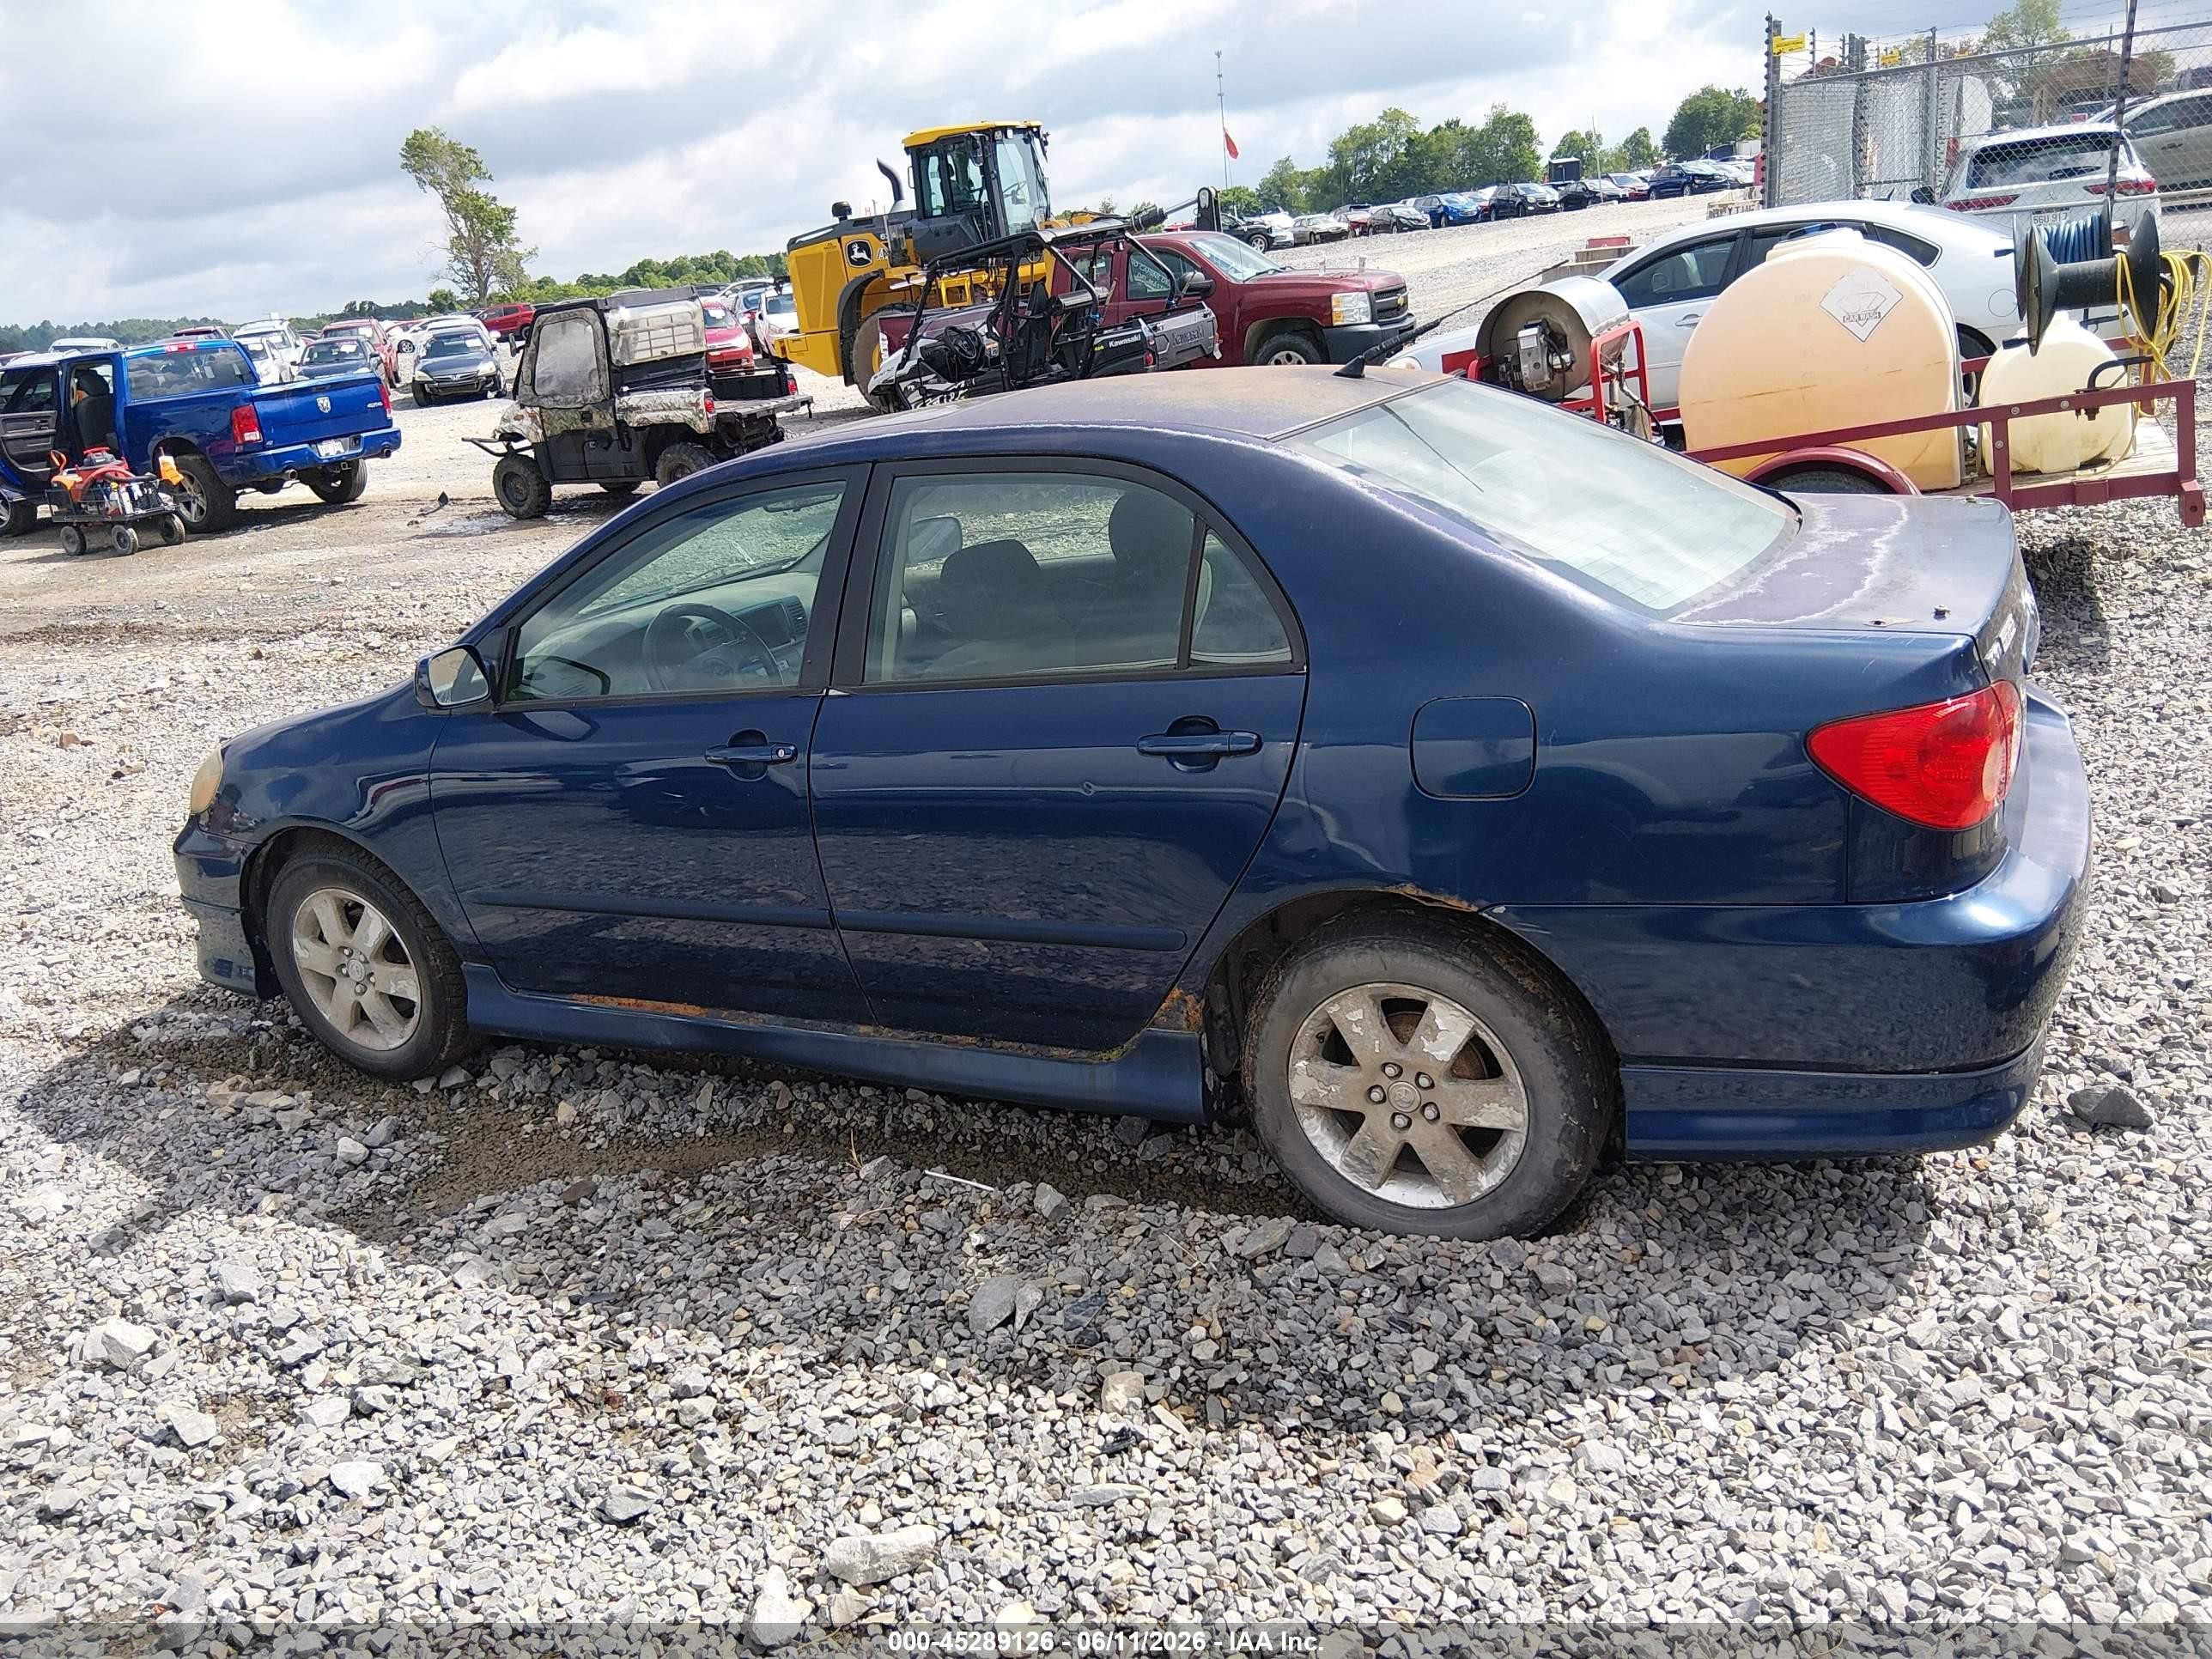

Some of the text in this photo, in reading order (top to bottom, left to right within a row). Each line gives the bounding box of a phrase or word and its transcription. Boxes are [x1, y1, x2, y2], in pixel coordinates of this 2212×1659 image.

[1859, 312, 1879, 321] WASH
[1109, 333, 1141, 348] Kawasaki
[1171, 324, 1205, 346] Kawasaki
